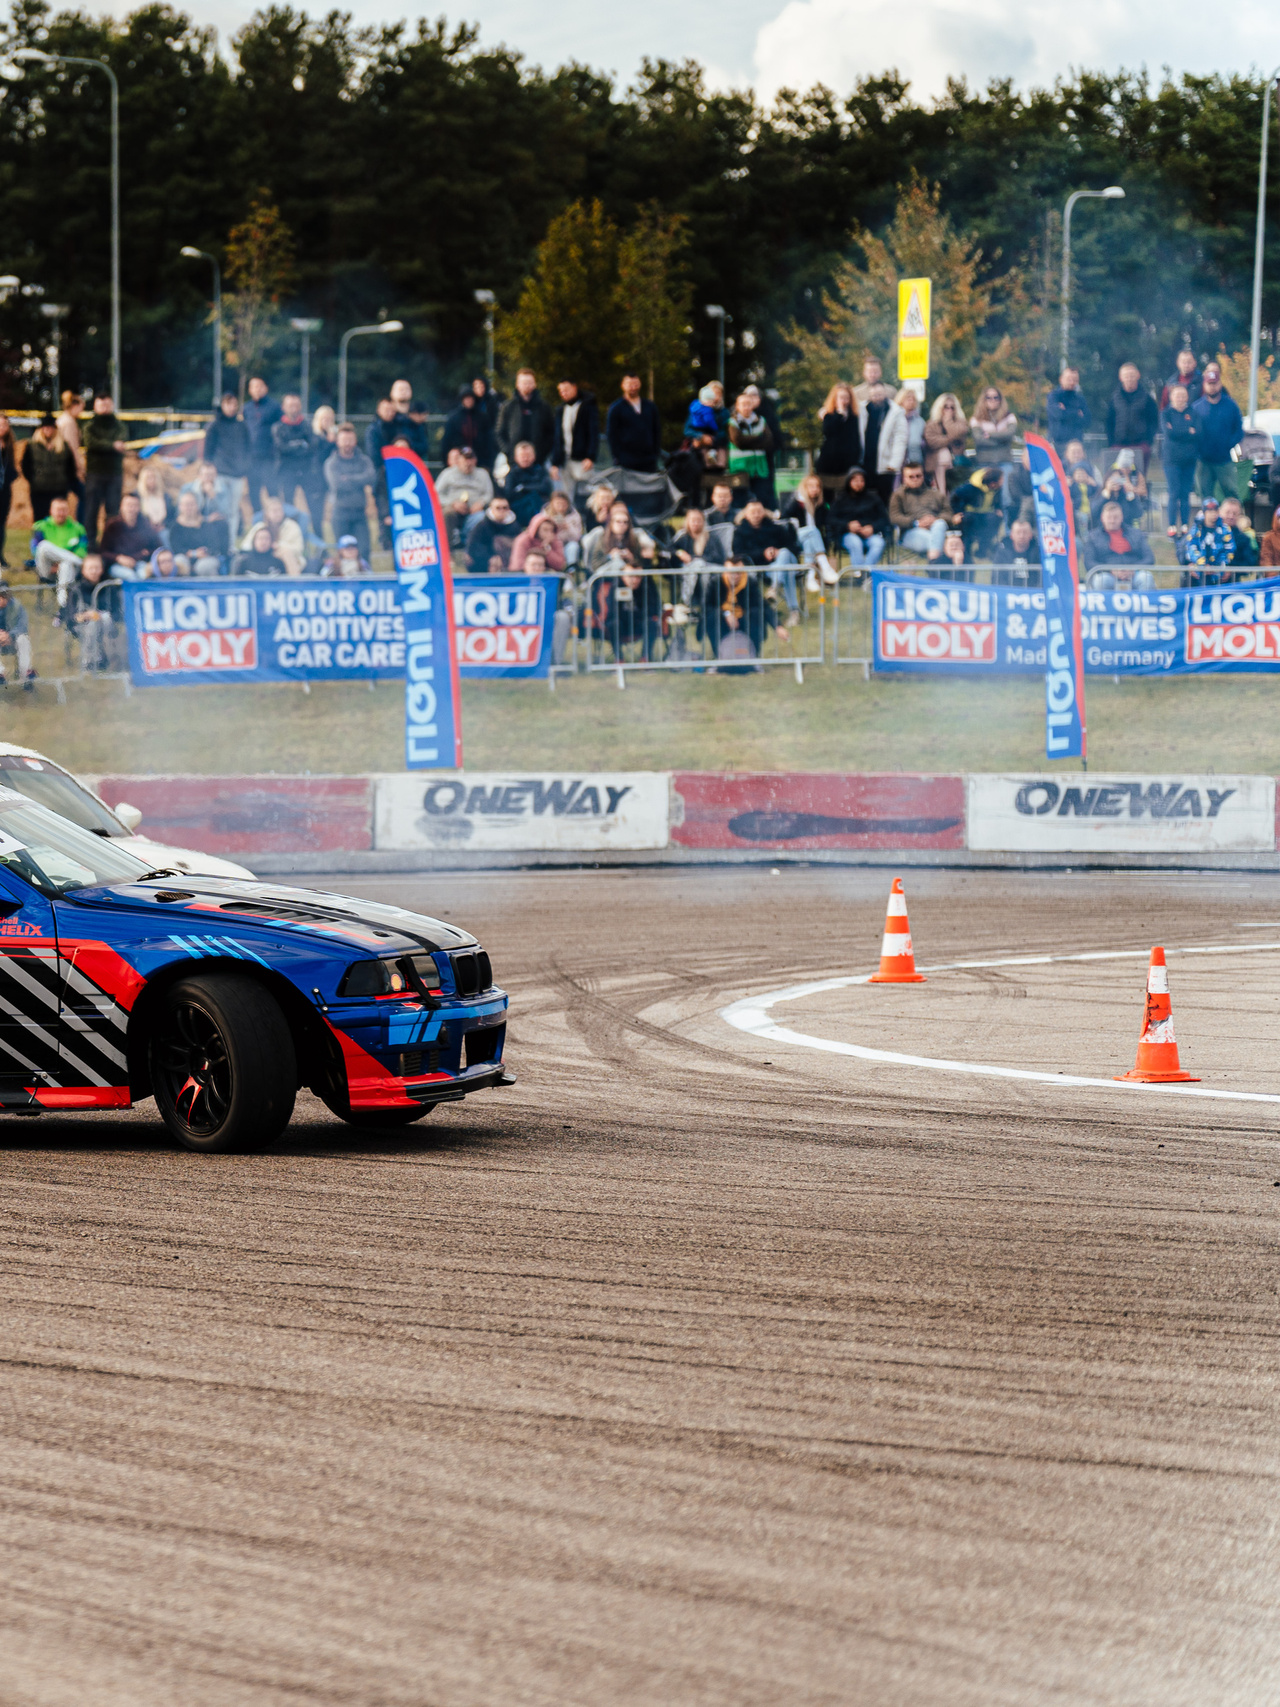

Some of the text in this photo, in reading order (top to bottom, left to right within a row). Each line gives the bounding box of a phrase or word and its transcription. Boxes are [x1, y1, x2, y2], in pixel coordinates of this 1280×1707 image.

[142, 594, 249, 632] LIQUI
[263, 590, 355, 616] MOTOR
[453, 590, 539, 628] IQUI
[885, 587, 991, 623] LIQUI
[1112, 592, 1178, 614] OILS
[1192, 591, 1280, 625] LIQU
[274, 615, 405, 642] ADDITIVES
[886, 622, 993, 658] MOLY
[1006, 613, 1029, 640] &
[145, 630, 253, 669] MOLY
[278, 643, 406, 668] CAR CARE
[455, 627, 539, 662] OLY
[1087, 645, 1176, 669] Germany
